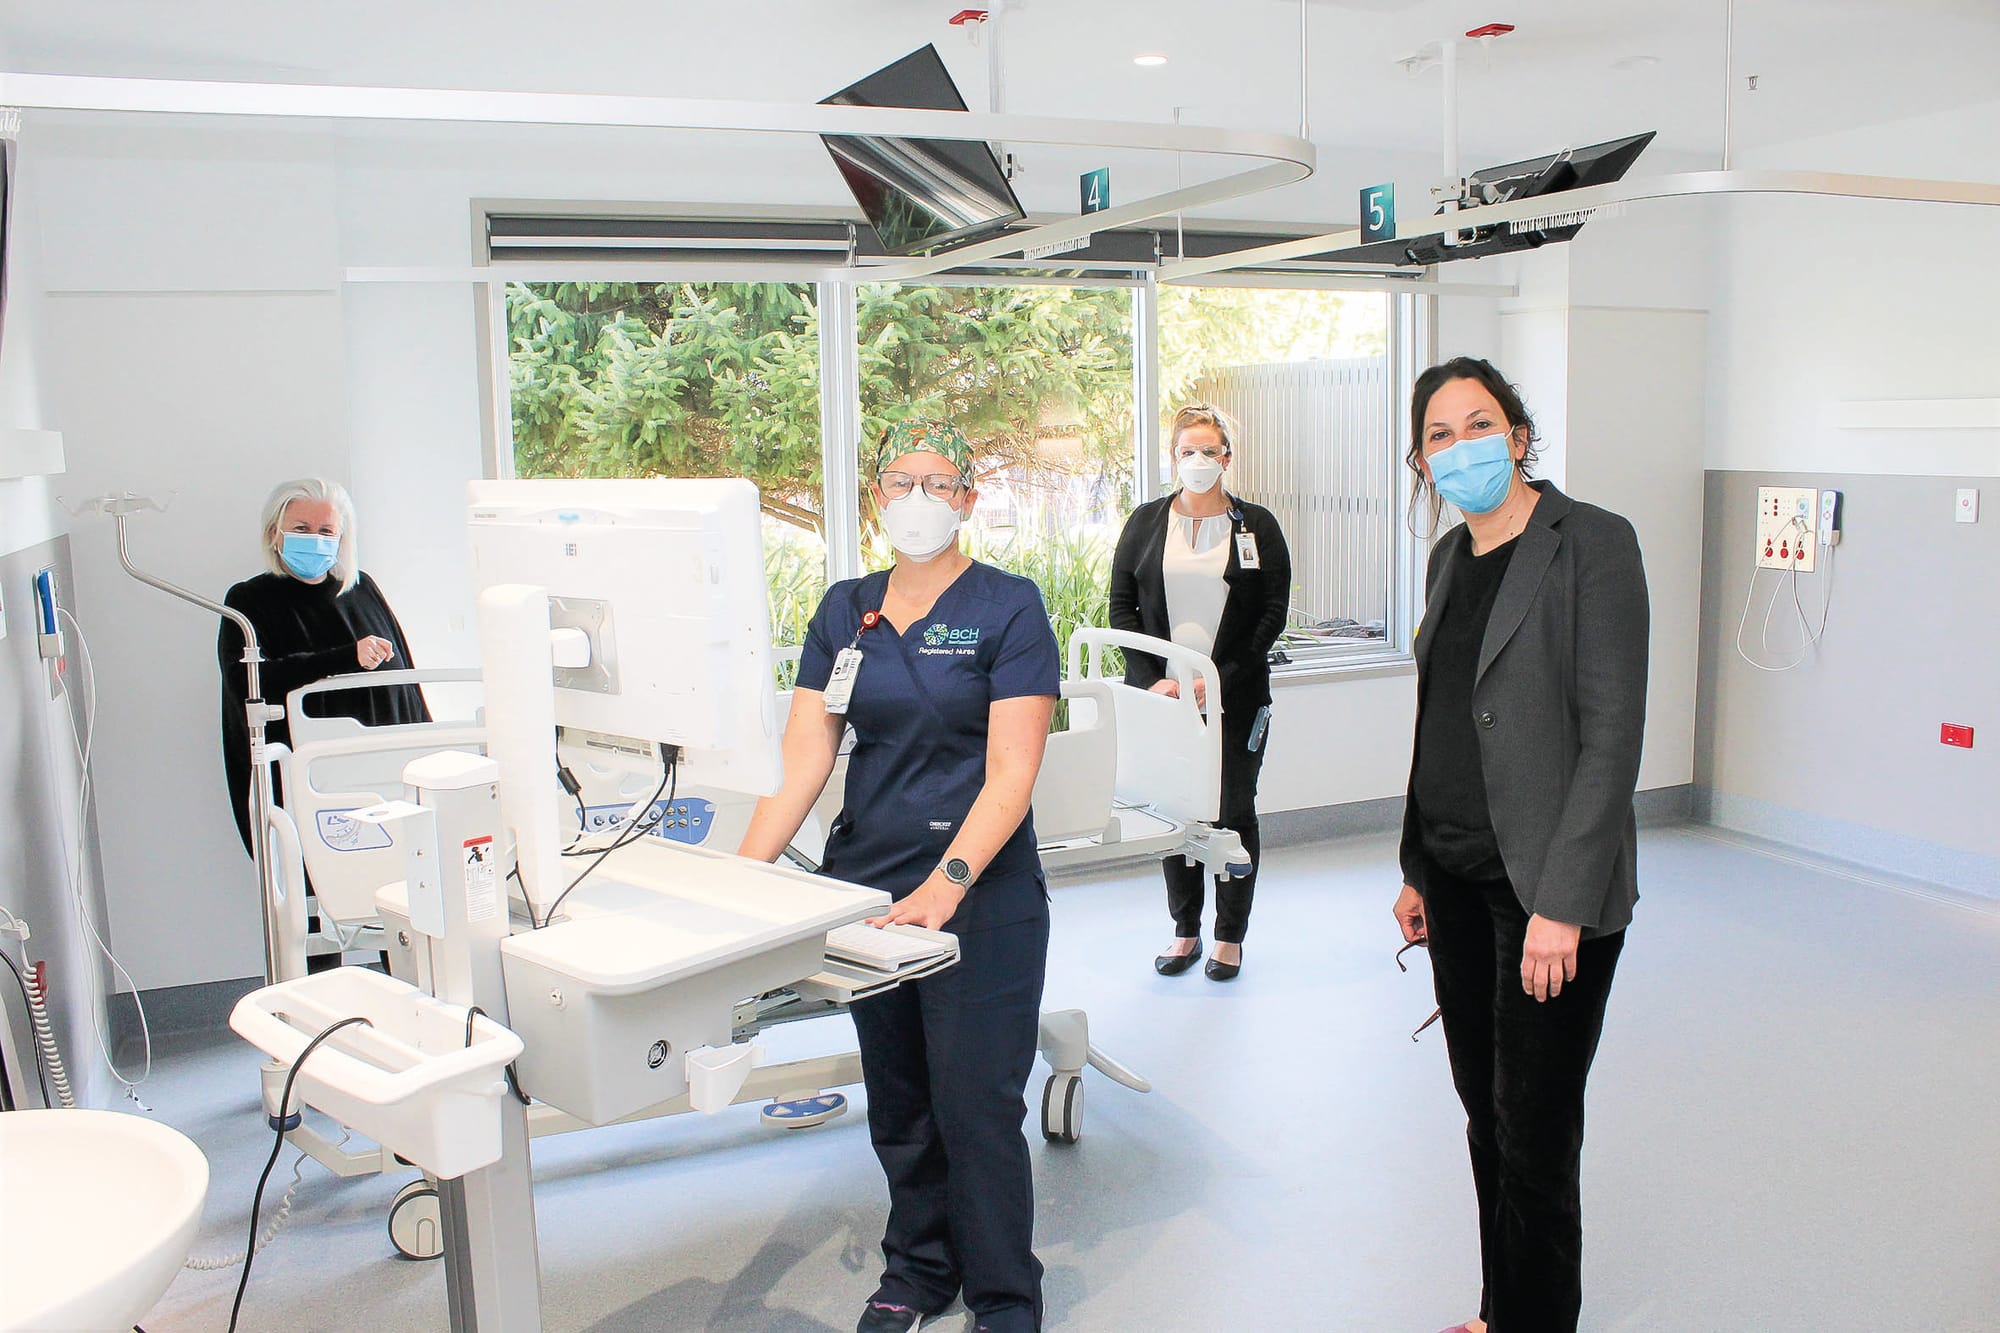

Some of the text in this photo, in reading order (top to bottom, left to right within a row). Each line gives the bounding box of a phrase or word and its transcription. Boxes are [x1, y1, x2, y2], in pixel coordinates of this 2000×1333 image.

[1088, 175, 1101, 212] 4
[1369, 191, 1385, 231] 5
[949, 628, 980, 640] BCH
[918, 646, 976, 656] Registered Nurse
